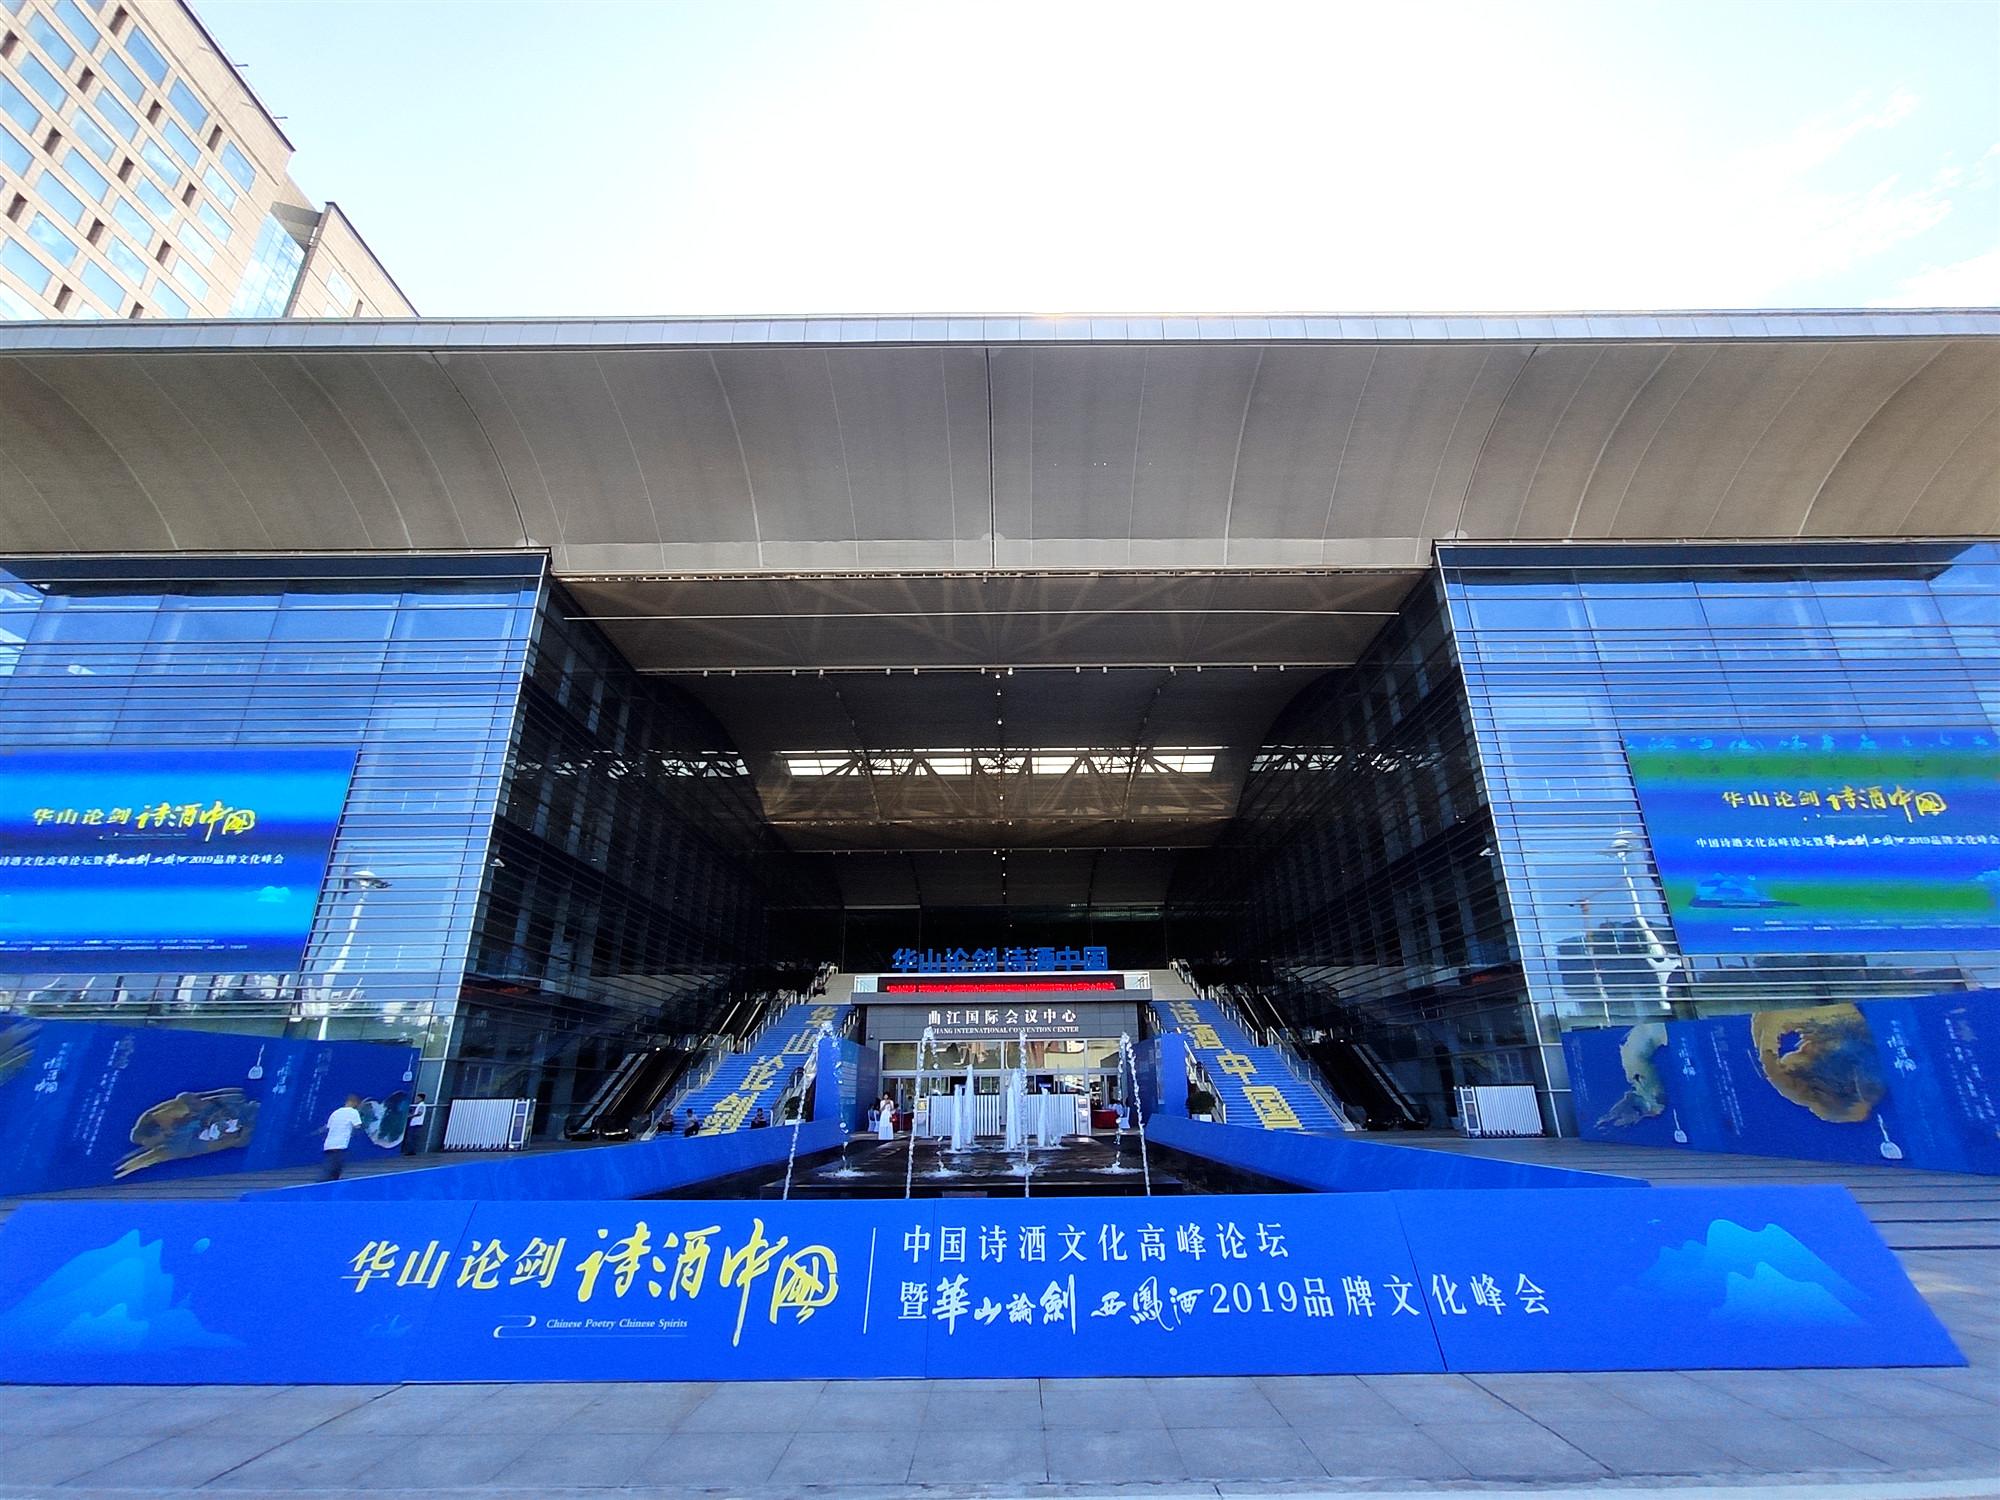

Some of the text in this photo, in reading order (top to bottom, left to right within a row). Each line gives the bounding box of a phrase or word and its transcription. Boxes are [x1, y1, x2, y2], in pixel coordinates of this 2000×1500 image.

[928, 1008, 1077, 1025] 曲江国际会议中心
[954, 1026, 1008, 1035] INTERNATIONAL
[1053, 1025, 1079, 1033] CENTER
[903, 1222, 1289, 1264] 中国诗酒文化高峰论坛
[341, 1237, 566, 1293] 华山论剑
[546, 1318, 688, 1330] Chinese Poetry Chinese Spirits
